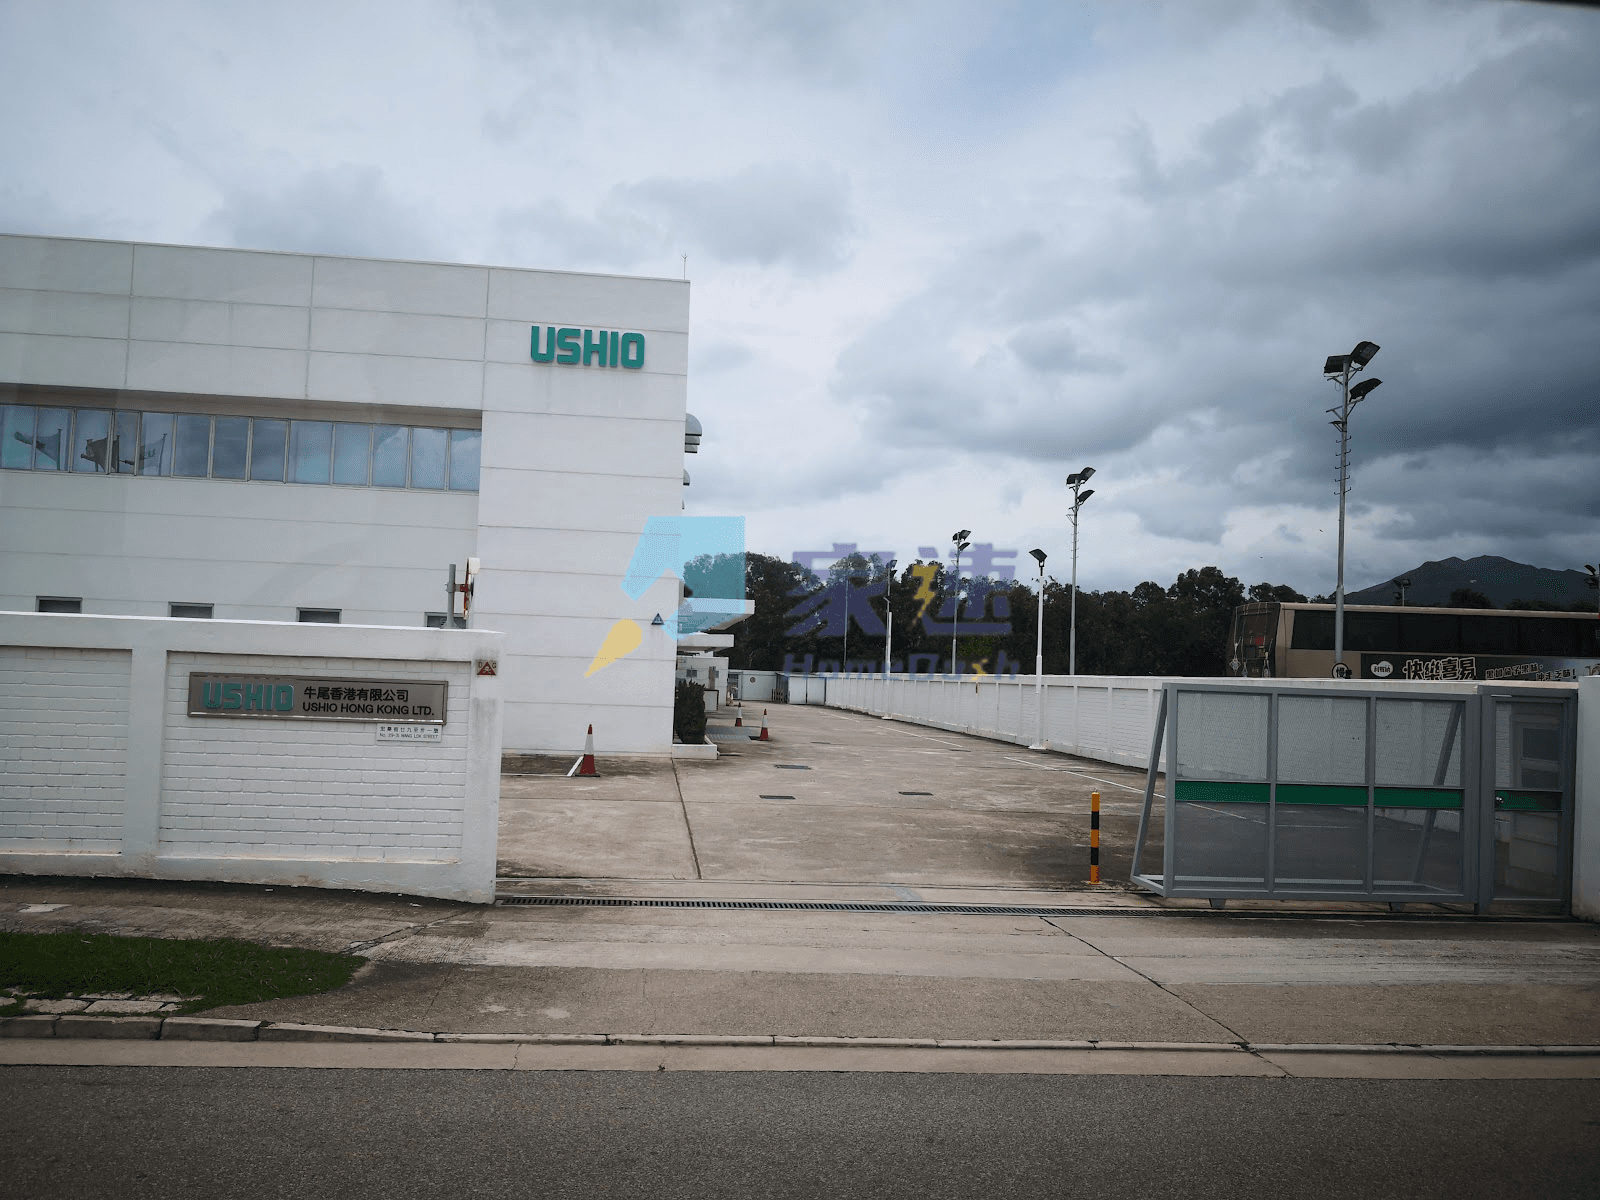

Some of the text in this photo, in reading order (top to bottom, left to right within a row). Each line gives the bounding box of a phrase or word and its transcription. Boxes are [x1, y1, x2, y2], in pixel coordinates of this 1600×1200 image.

[531, 325, 645, 369] USHIO
[203, 682, 294, 711] USHIO
[304, 686, 409, 701] 牛尾香港有限公司
[302, 702, 435, 716] USHIO HONG KONG LTD.
